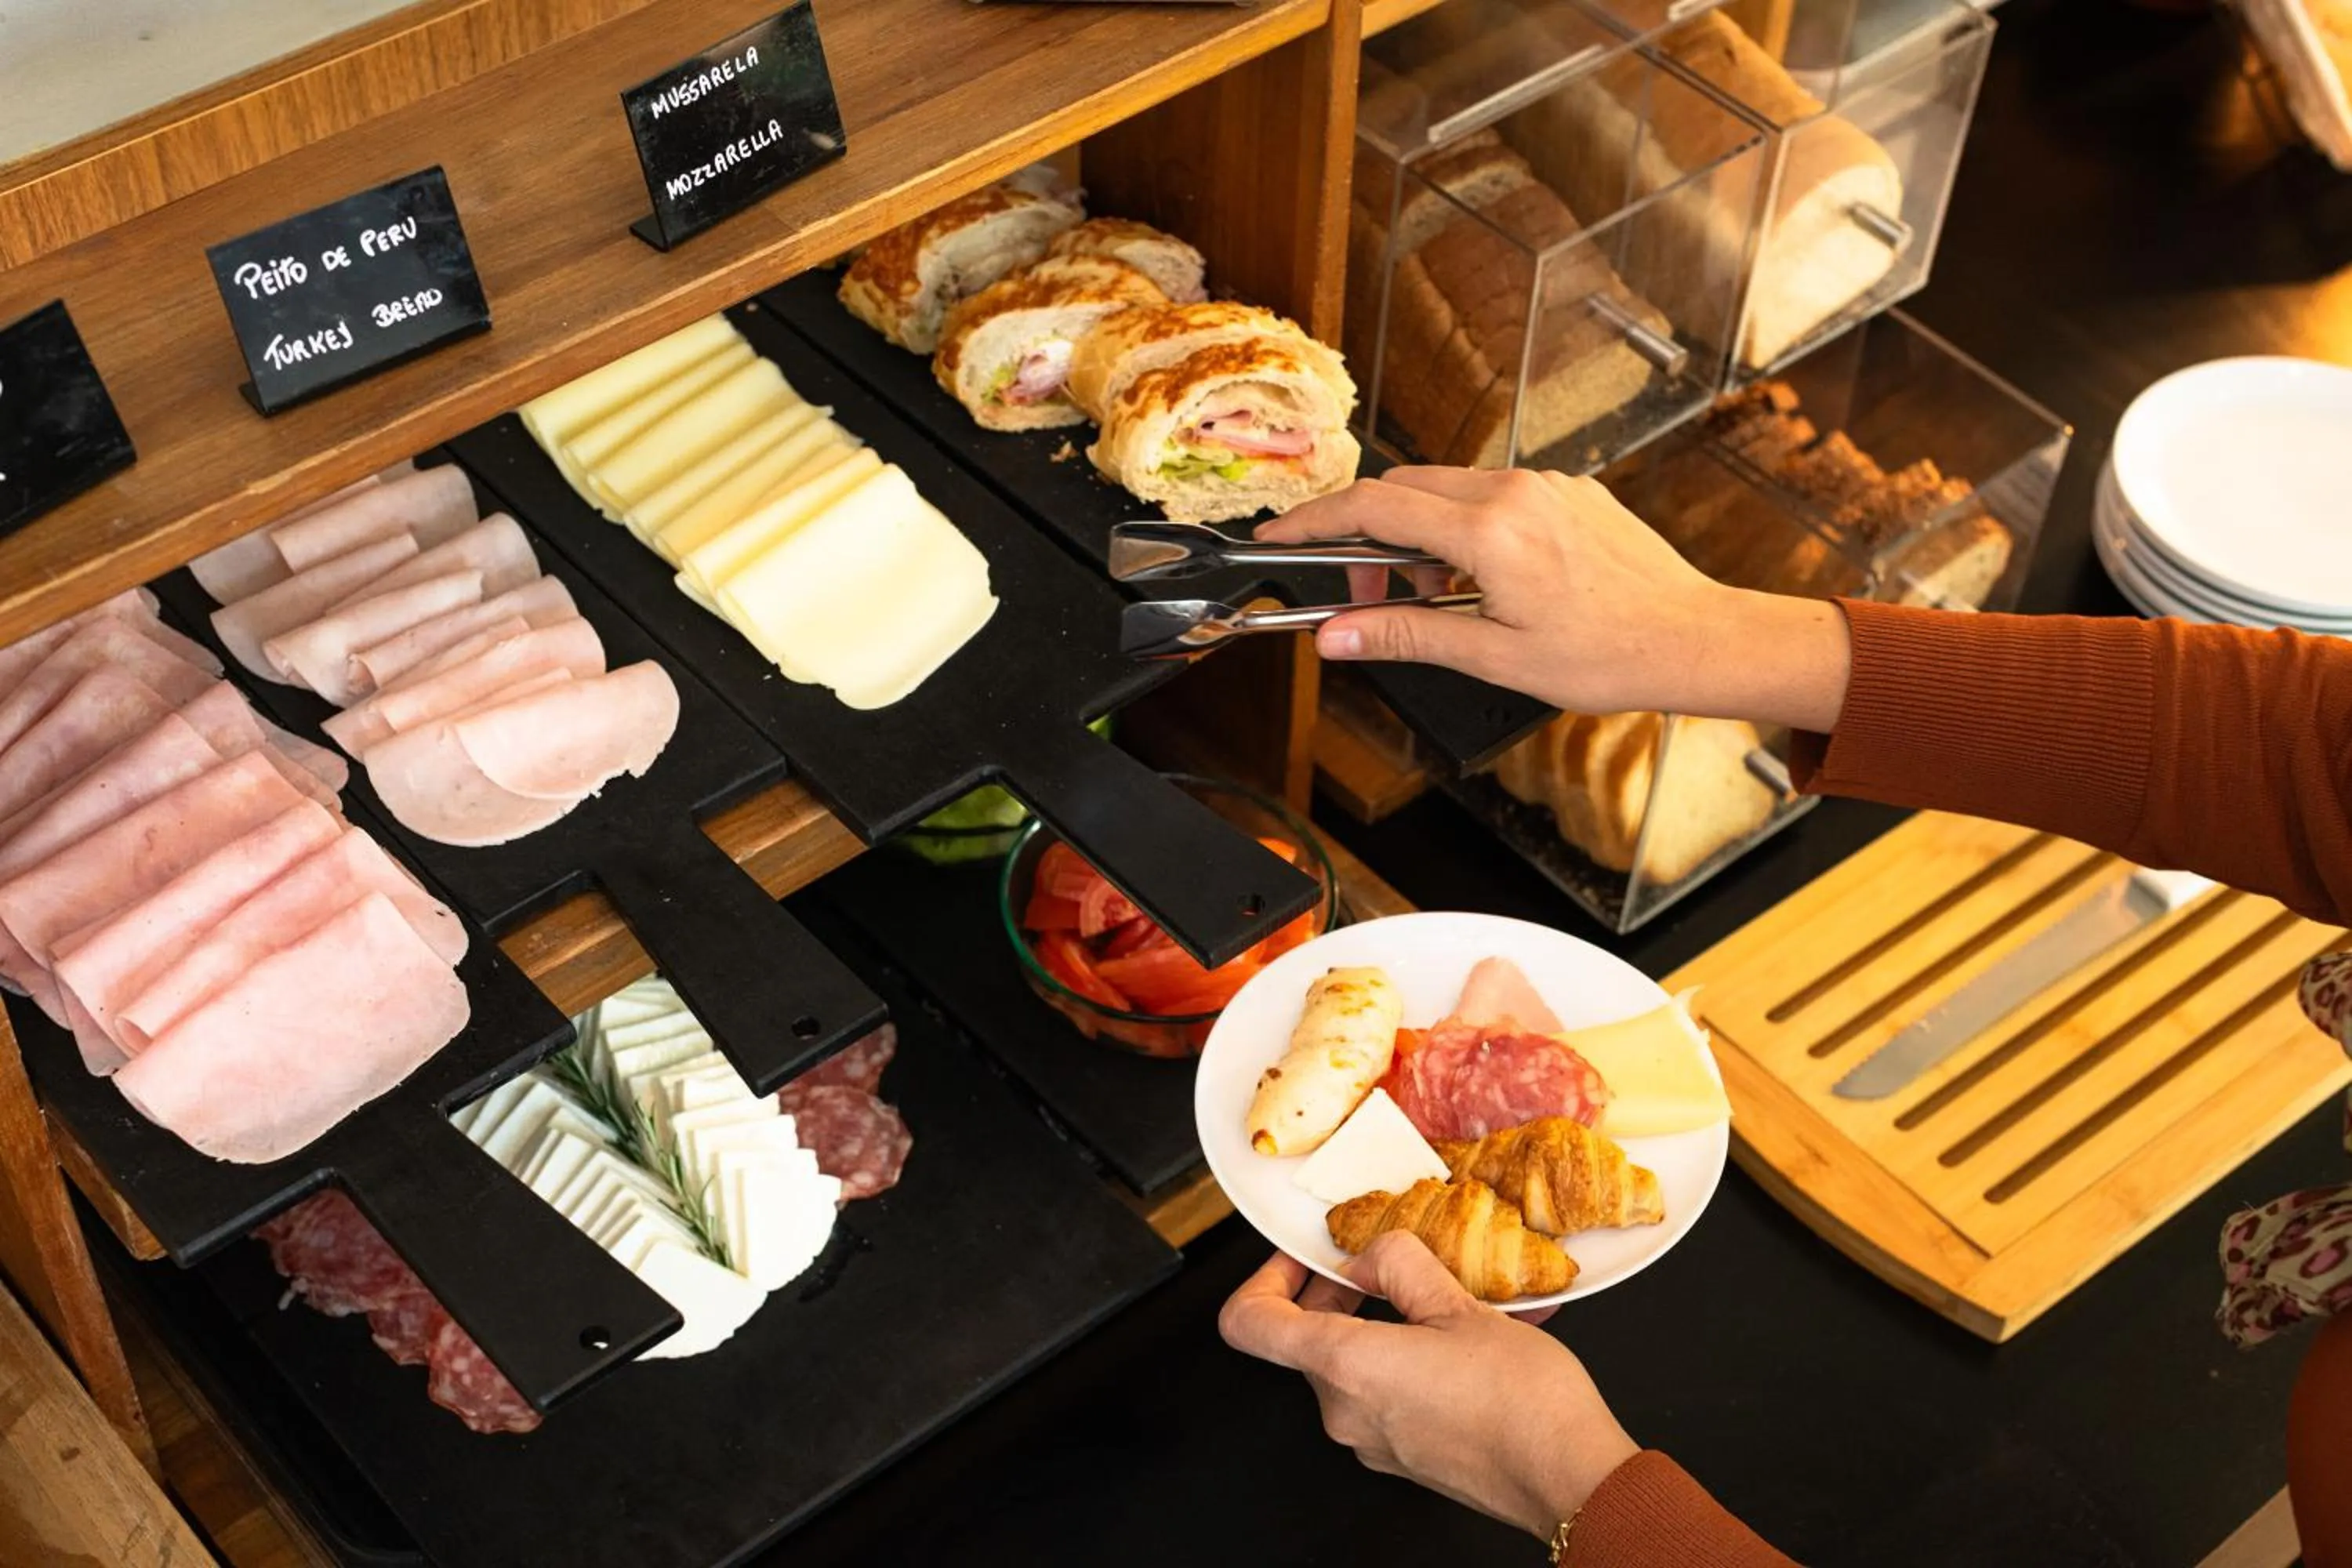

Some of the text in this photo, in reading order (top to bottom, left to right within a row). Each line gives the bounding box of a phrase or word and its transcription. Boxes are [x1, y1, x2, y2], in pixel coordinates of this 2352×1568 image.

[651, 45, 759, 119] MUSSARELA
[666, 119, 783, 201] MOZZARELLA
[321, 245, 351, 271] DE
[359, 216, 416, 257] PERU
[371, 288, 443, 328] BREAD
